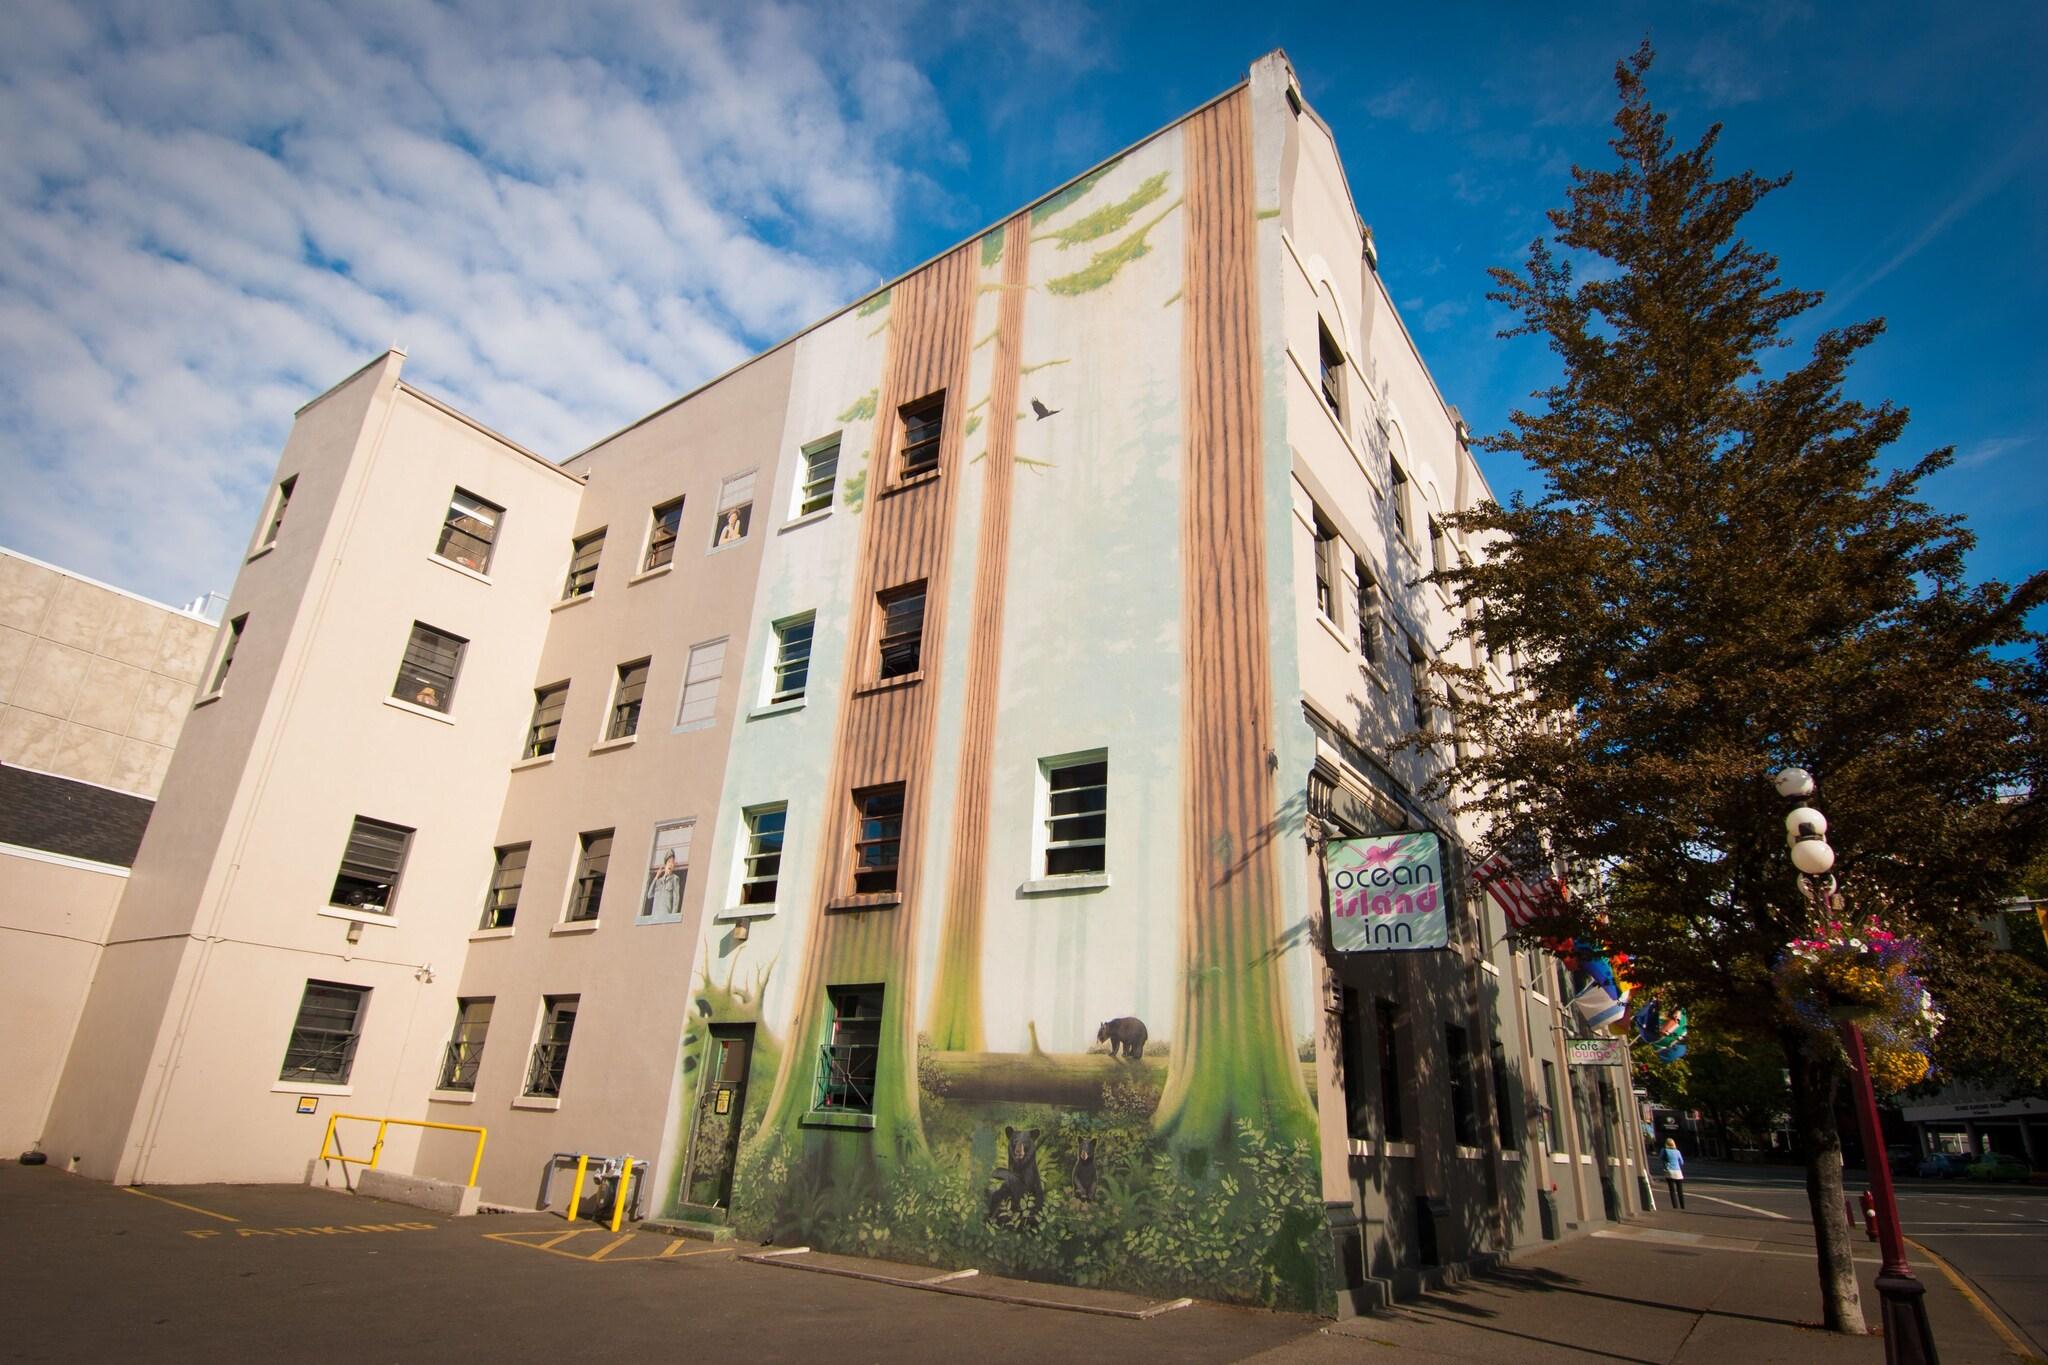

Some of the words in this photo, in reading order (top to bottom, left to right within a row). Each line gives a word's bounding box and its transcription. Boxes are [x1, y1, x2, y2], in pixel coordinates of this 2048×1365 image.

[1335, 864, 1433, 889] ocean
[1335, 884, 1437, 917] island
[1364, 918, 1412, 944] inn
[1572, 1049, 1610, 1061] lounge
[184, 1222, 437, 1238] PARKING
